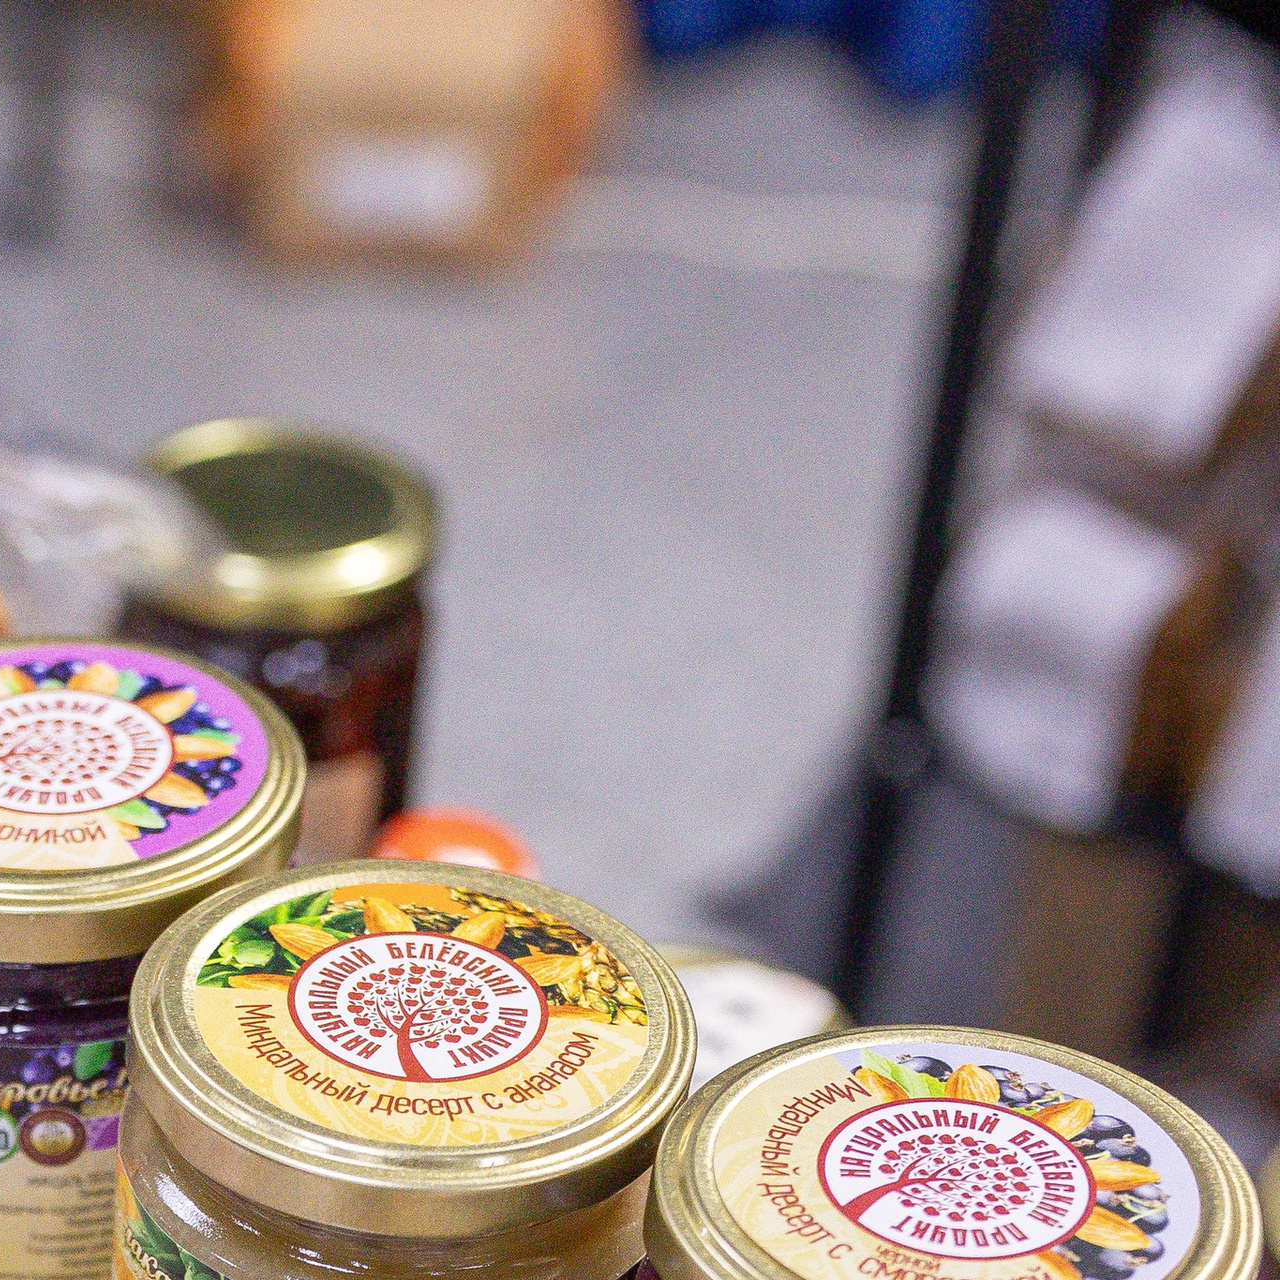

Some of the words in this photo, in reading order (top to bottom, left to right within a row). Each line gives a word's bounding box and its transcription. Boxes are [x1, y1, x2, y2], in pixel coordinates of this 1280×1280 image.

[311, 945, 384, 1061] НАТУРАЛЬНЫЙ
[384, 938, 524, 999] БЕЛЁВСКИЙ
[234, 1002, 370, 1106] Миндальный
[370, 1091, 477, 1123] десерт
[483, 1091, 505, 1111] с
[507, 1029, 601, 1104] ананасом
[448, 1004, 530, 1069] ПРОДУКТ
[758, 1076, 874, 1188] Миндальный
[838, 1109, 1002, 1180] НАТУРАЛЬНЫЙ
[757, 1172, 836, 1248] десерт
[1005, 1129, 1090, 1231] БЕЛЁВСКИЙ
[828, 1240, 847, 1261] с
[874, 1244, 941, 1272] черной
[892, 1214, 1031, 1249] ПРОДУКТ
